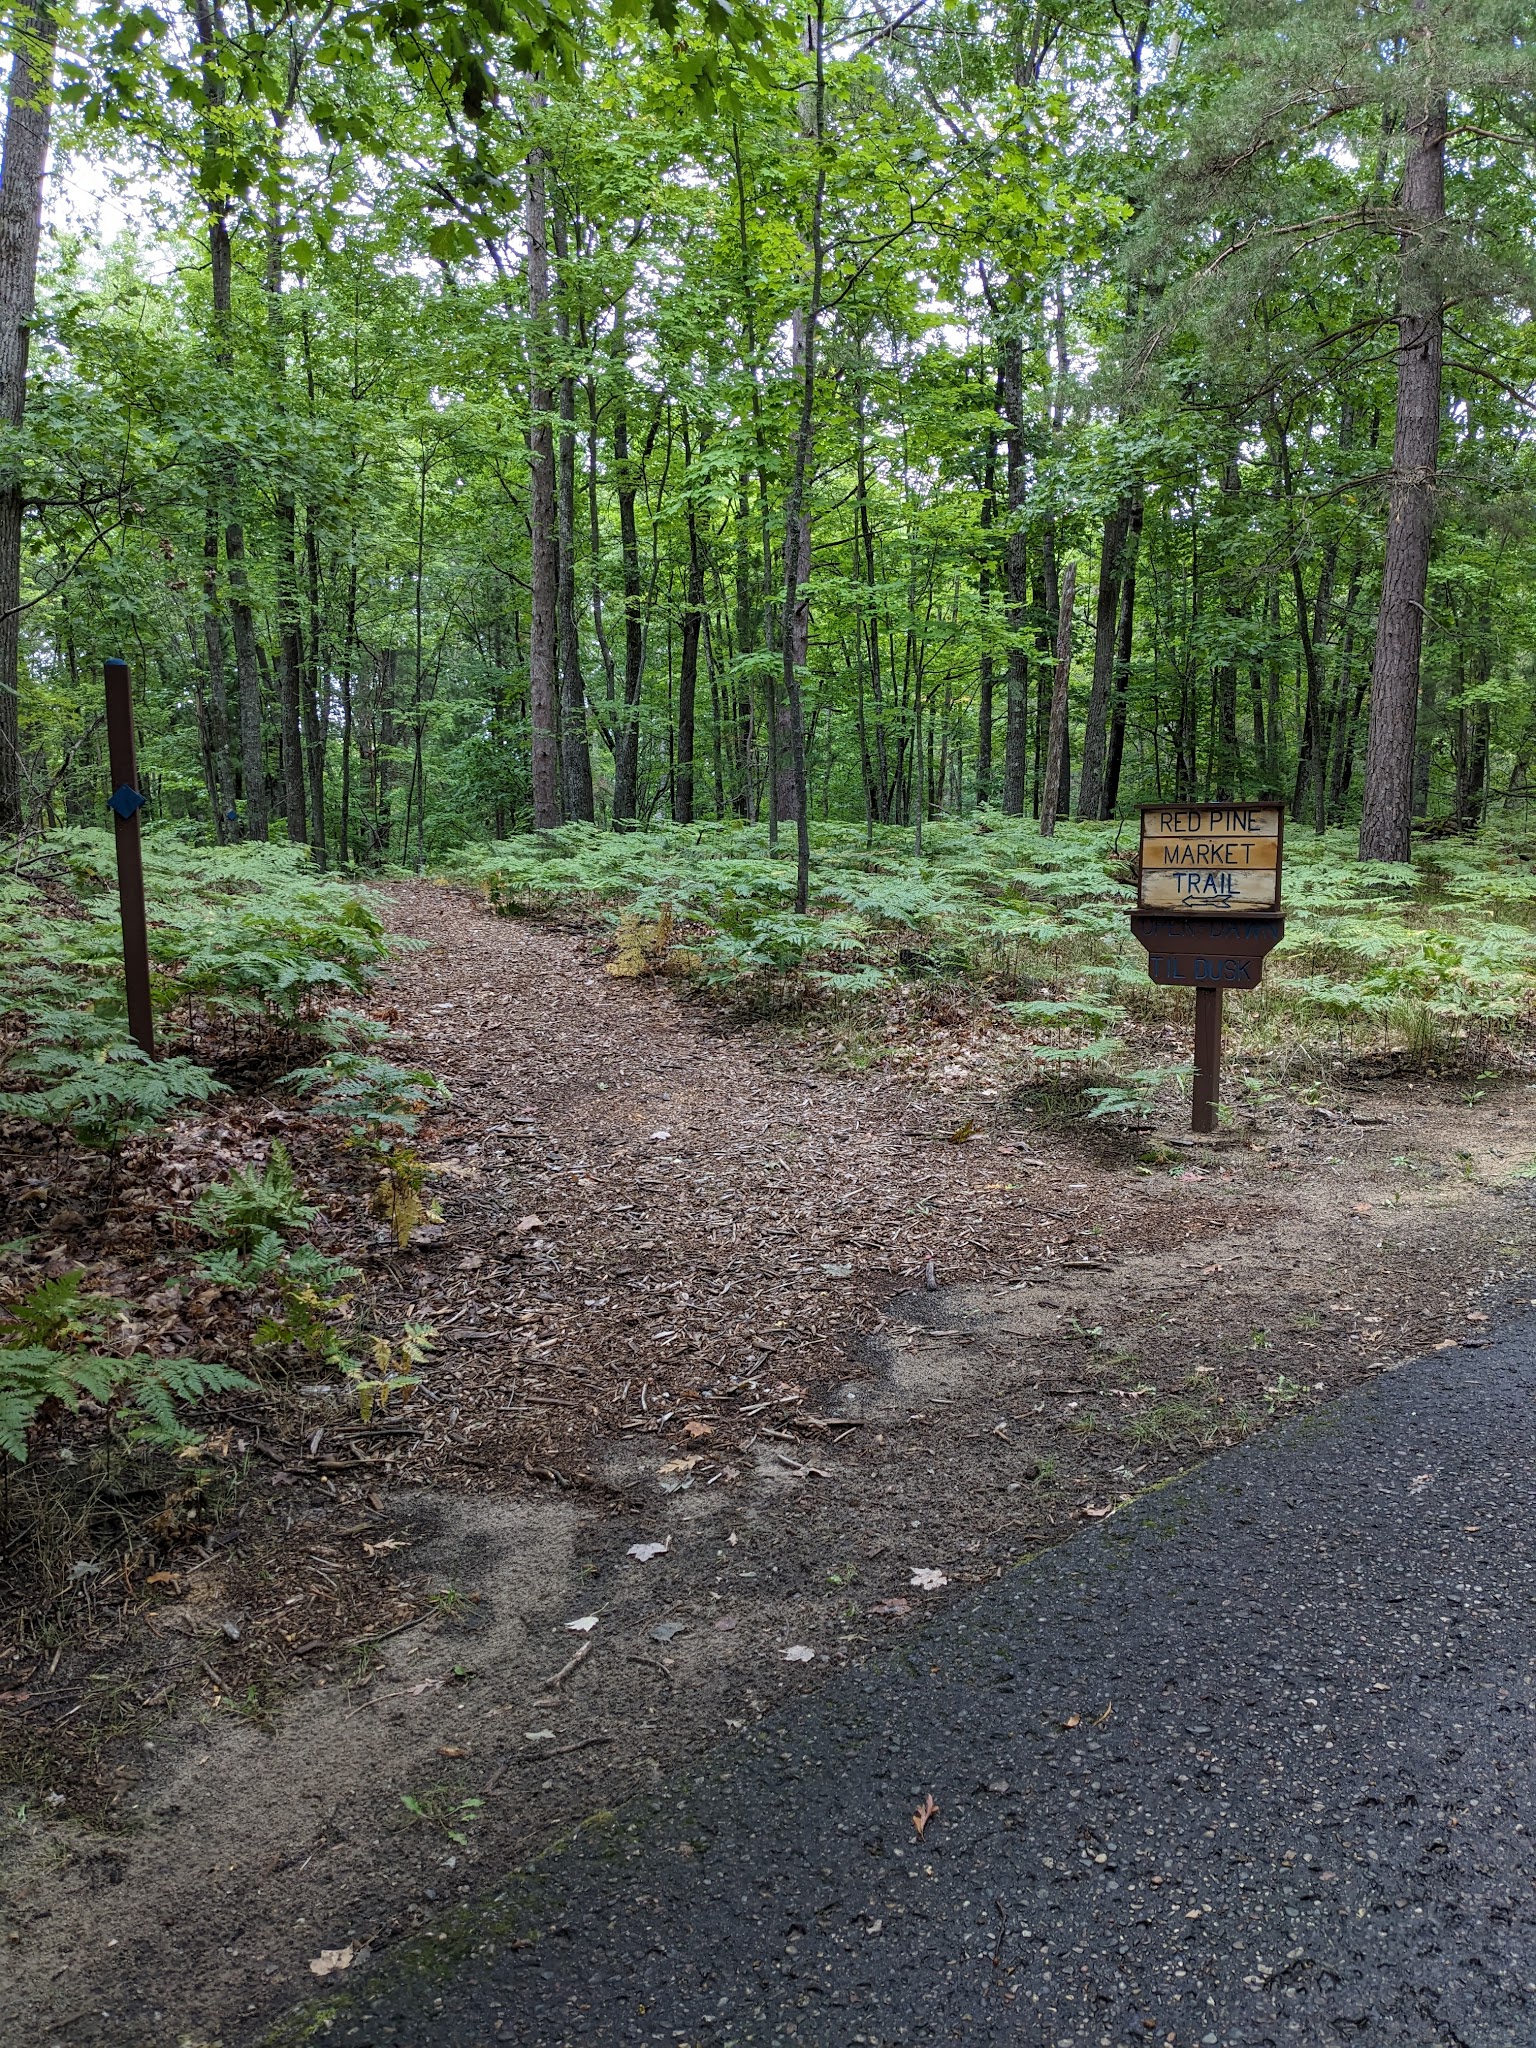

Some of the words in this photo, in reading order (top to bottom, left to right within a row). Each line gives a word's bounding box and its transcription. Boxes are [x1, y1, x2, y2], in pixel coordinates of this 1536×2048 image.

[1160, 811, 1200, 832] RED
[1210, 810, 1261, 832] PINE
[1164, 843, 1255, 864] MARKET
[1173, 872, 1240, 895] TRAIL
[1150, 956, 1186, 979] TIL
[1194, 957, 1251, 982] DUSK
